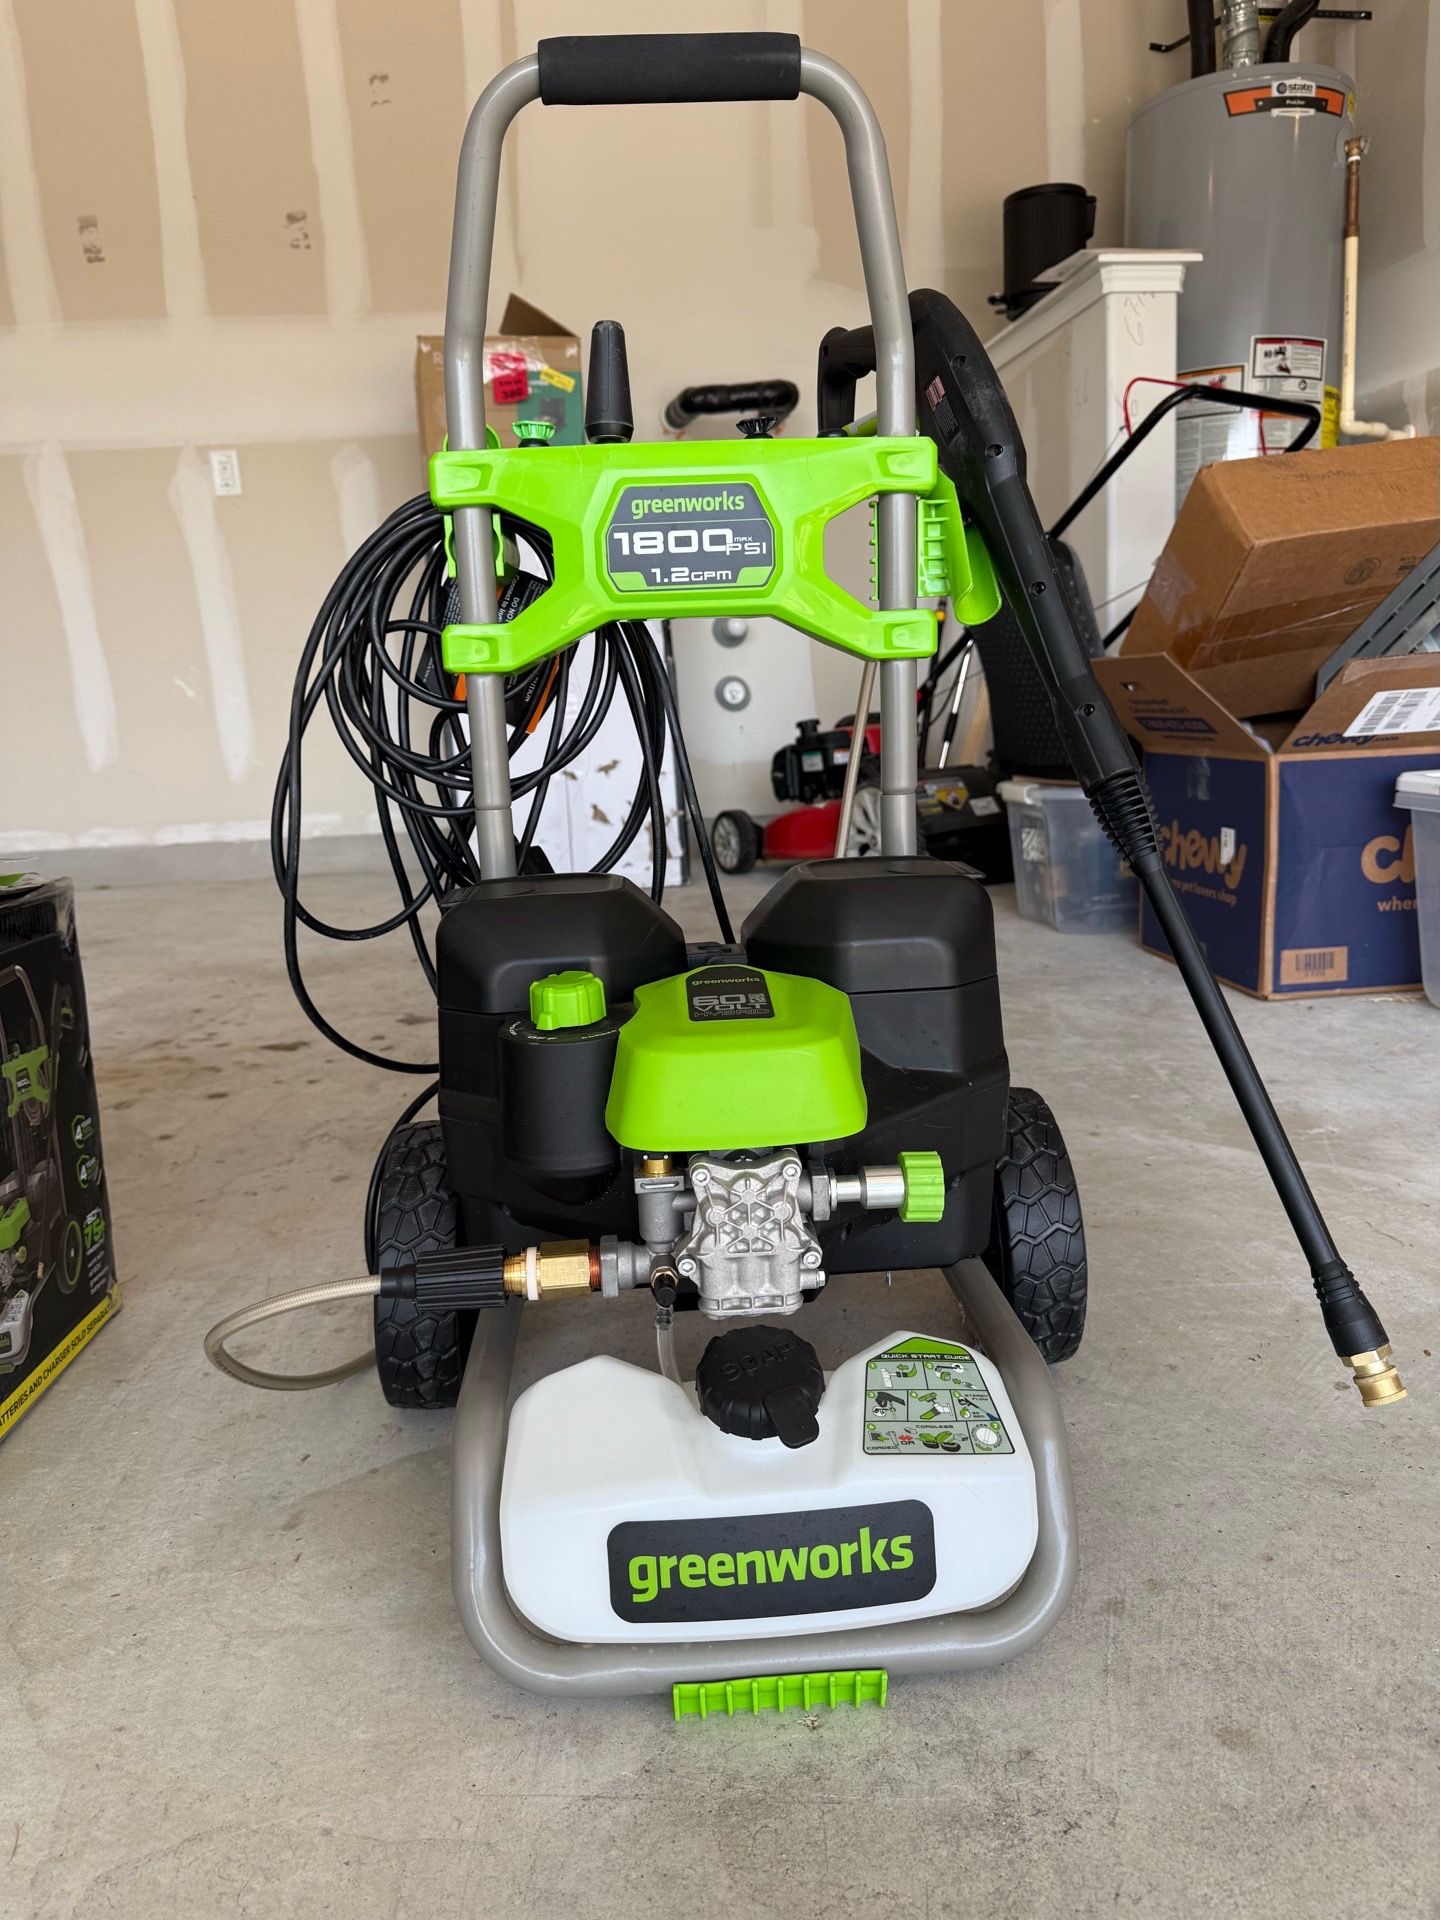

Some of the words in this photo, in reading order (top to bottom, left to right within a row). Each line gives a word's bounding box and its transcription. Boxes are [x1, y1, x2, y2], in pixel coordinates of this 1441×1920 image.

[1288, 83, 1314, 92] state
[631, 490, 745, 520] greenworks
[613, 528, 734, 556] 1800
[726, 542, 767, 556] PSI
[692, 977, 760, 986] greenworks
[693, 994, 747, 1006] 60
[694, 1003, 767, 1012] VOLT
[75, 1125, 83, 1140] 4
[80, 1165, 88, 1180] 4
[28, 1376, 43, 1396] AND
[43, 1345, 72, 1381] CHARGER
[70, 1329, 87, 1350] SOLD
[721, 1342, 794, 1382] SOAP
[628, 1526, 914, 1603] greenworks
